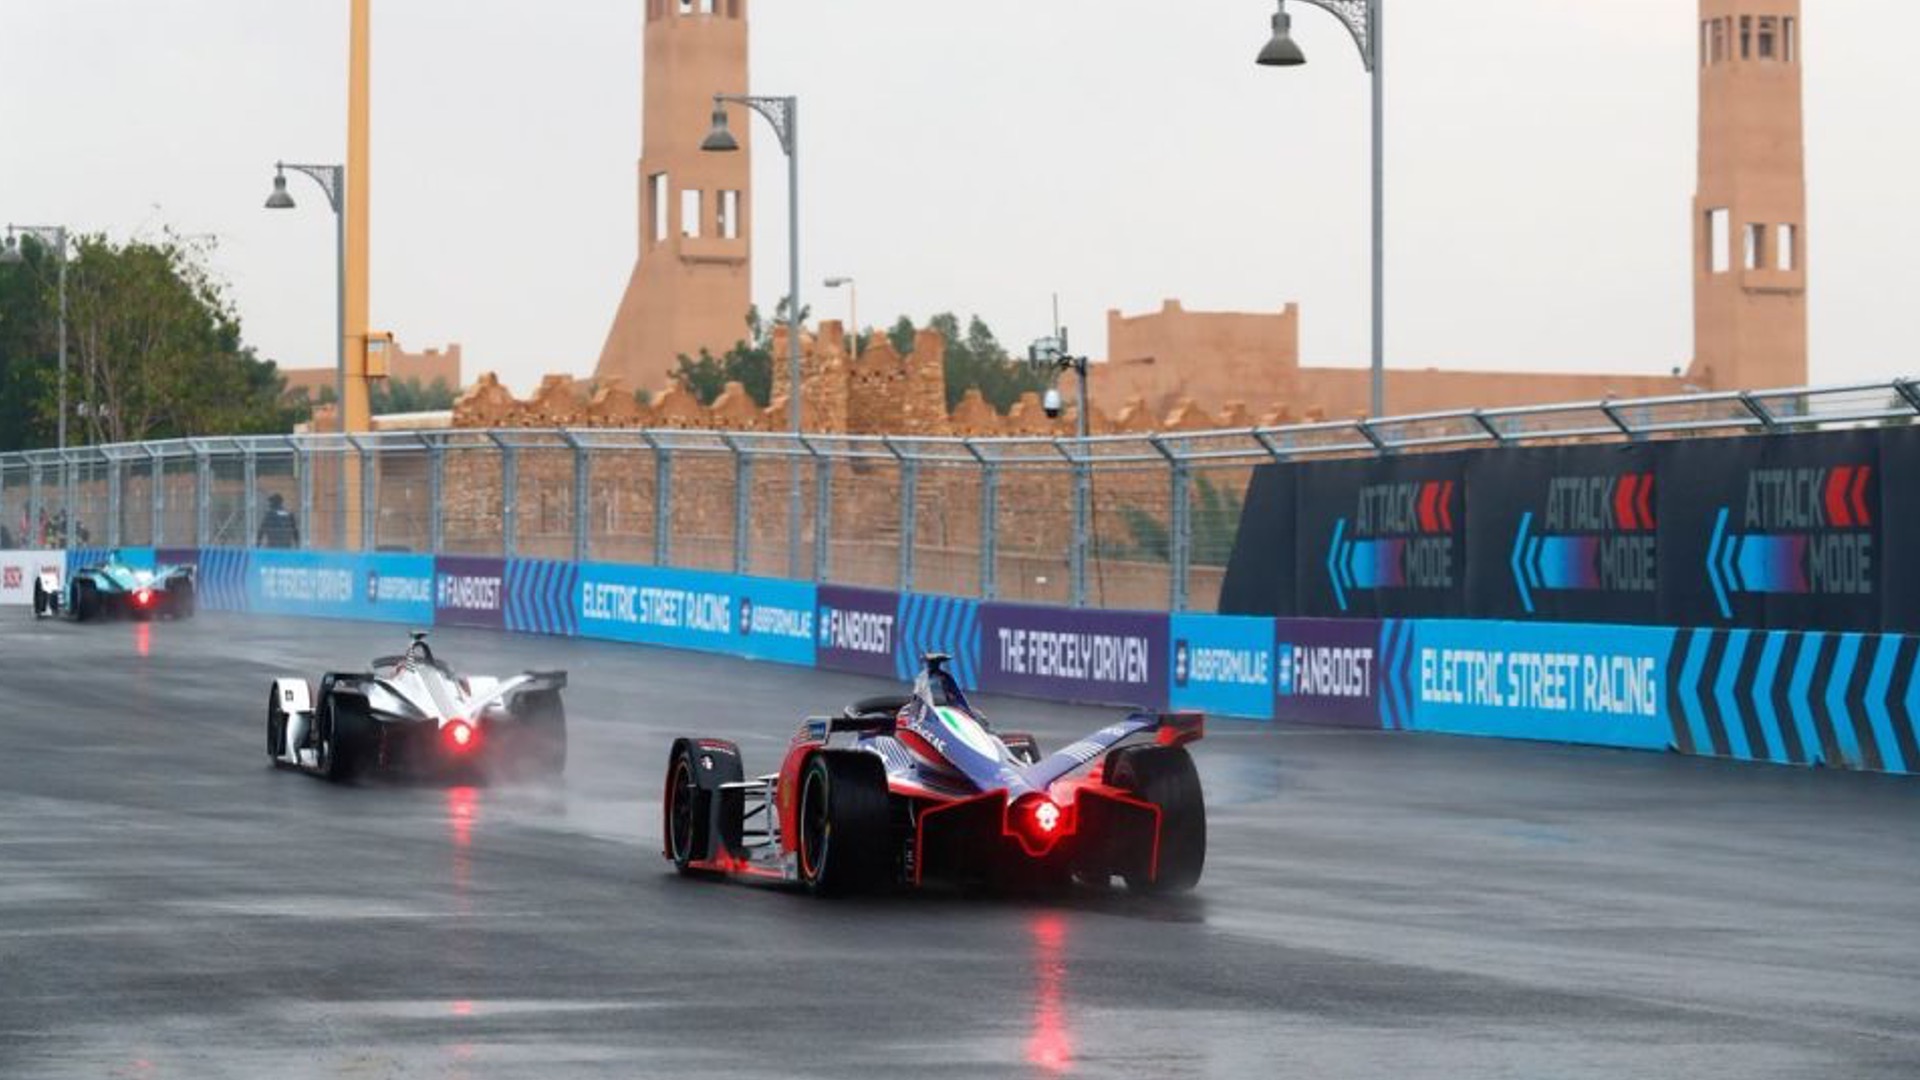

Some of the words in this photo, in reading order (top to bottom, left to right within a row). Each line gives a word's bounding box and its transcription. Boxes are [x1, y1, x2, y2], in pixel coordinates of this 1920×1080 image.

[1356, 483, 1419, 534] ATTACK
[1544, 476, 1616, 530] ATTACK
[1745, 467, 1826, 528] ATTACK
[1405, 538, 1453, 585] MODE
[1601, 536, 1656, 592] MODE
[1809, 534, 1873, 594] MODE
[438, 574, 501, 610] #FANBOOST
[583, 582, 637, 622] ELECTRIC
[640, 587, 685, 626] STREET
[686, 592, 730, 633] RACING
[818, 607, 893, 655] #FANBOOST
[998, 627, 1026, 674] THE
[1028, 630, 1092, 680] FIERCELY
[1093, 634, 1148, 683] DRIVEN
[1279, 645, 1373, 697] #FANBOOST
[1421, 648, 1503, 706] ELECTRIC
[1507, 651, 1580, 710] STREET
[1583, 653, 1657, 716] RACING
